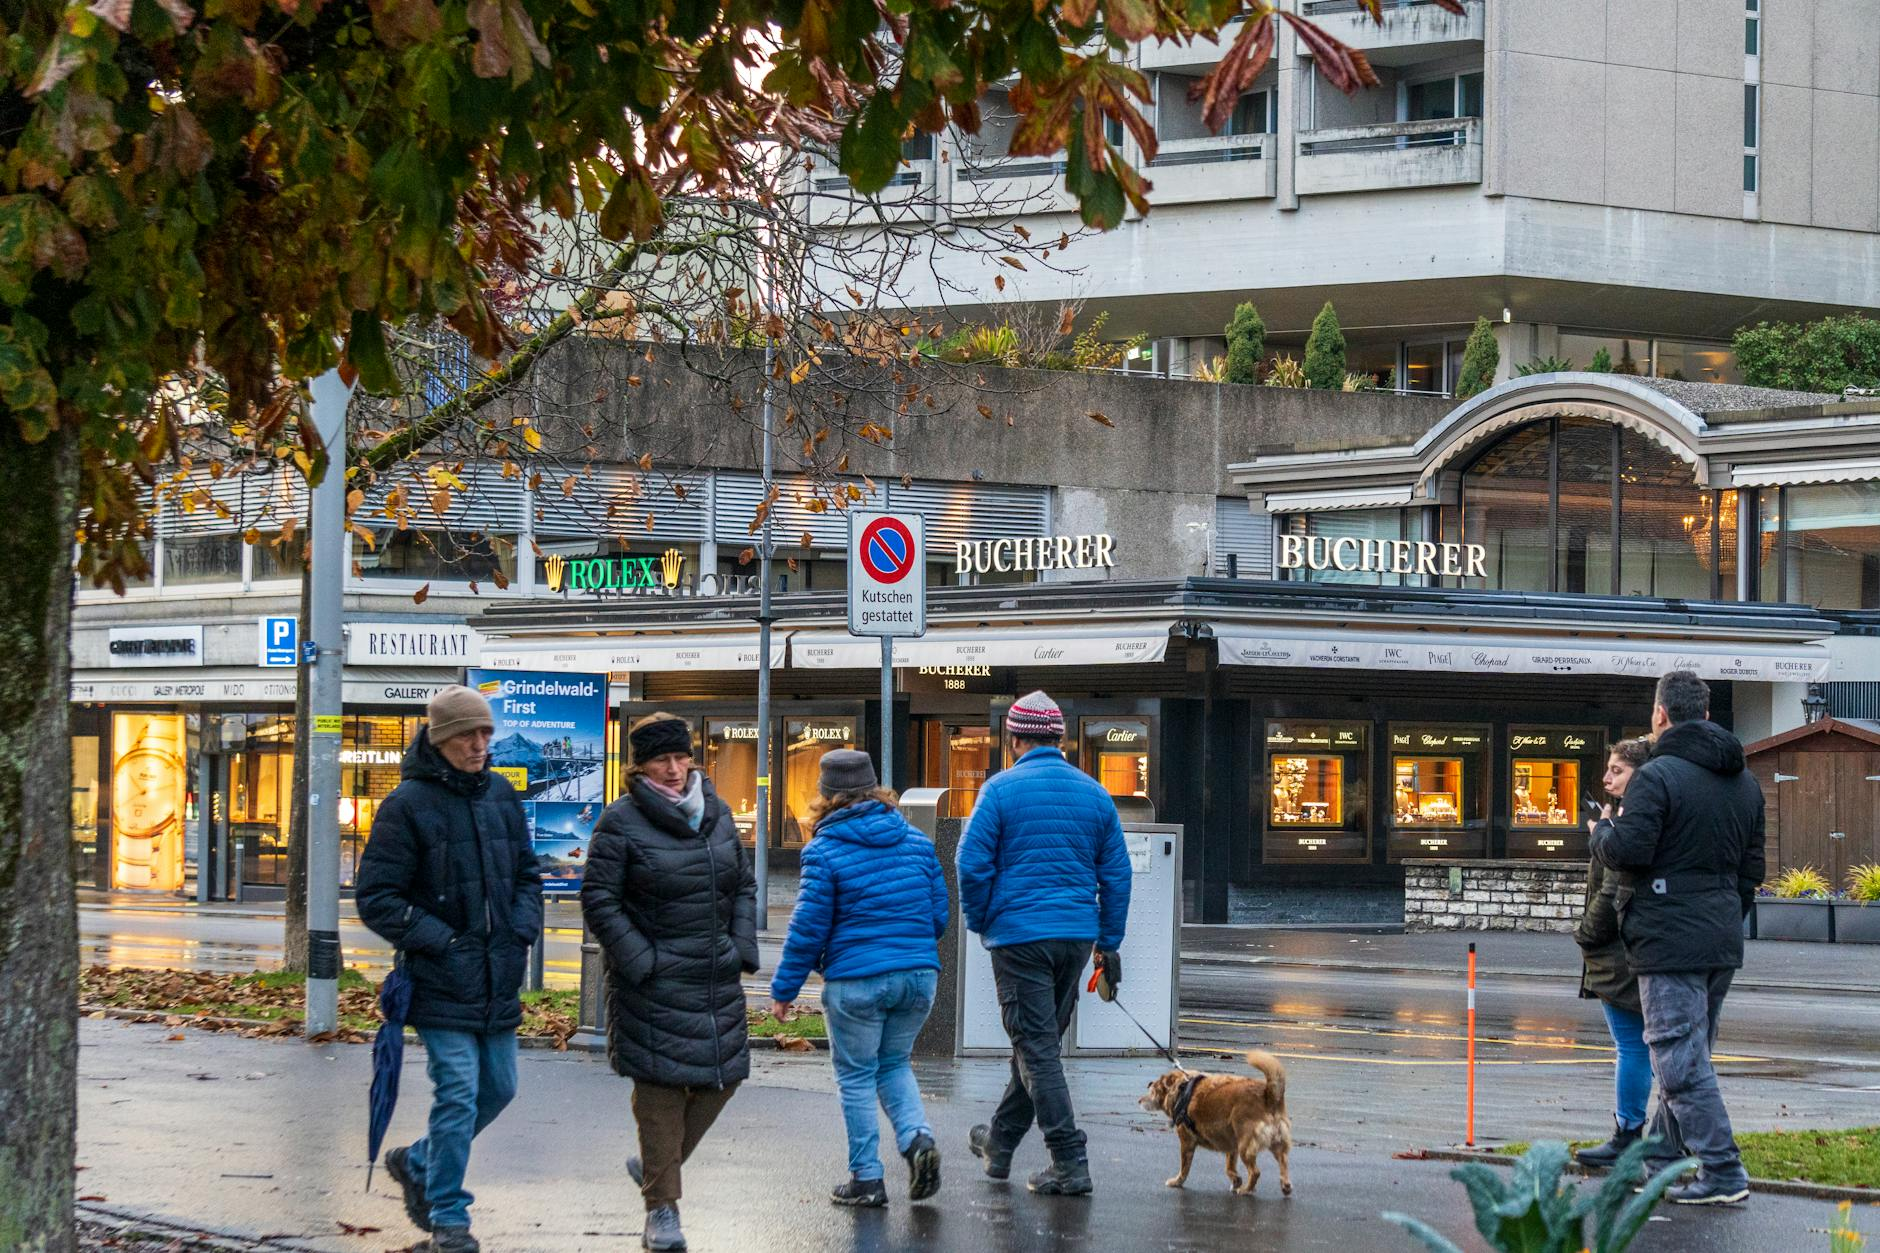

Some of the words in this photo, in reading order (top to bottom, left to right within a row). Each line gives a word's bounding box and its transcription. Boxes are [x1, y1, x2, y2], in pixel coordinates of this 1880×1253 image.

[955, 534, 1115, 574] BUCHERER
[1279, 534, 1488, 577] BUCHERER
[570, 557, 656, 589] ROLEX
[862, 589, 913, 604] Kutschen
[862, 610, 913, 625] gestattet
[273, 621, 290, 646] P
[369, 633, 468, 656] RESTAURANT
[956, 646, 986, 654] BUCHERER
[1115, 642, 1147, 651] BUCHERER
[743, 654, 761, 662] ROLE
[1033, 646, 1065, 660] Cartier
[1385, 648, 1403, 658] IWC
[1428, 652, 1453, 665] PIAGET
[1471, 652, 1511, 668] Chopard
[1775, 662, 1813, 671] BUCHERER
[223, 684, 244, 696] MIDO
[503, 679, 599, 697] Grindelwald-
[944, 679, 966, 690] 1888
[384, 687, 430, 699] GALLERY
[503, 699, 537, 715] First
[503, 719, 518, 728] TOP
[520, 720, 530, 728] OF
[531, 720, 576, 729] ADVENTURE
[812, 728, 842, 740] ROLEX
[1106, 728, 1138, 743] Cartier
[1339, 732, 1353, 740] IWC
